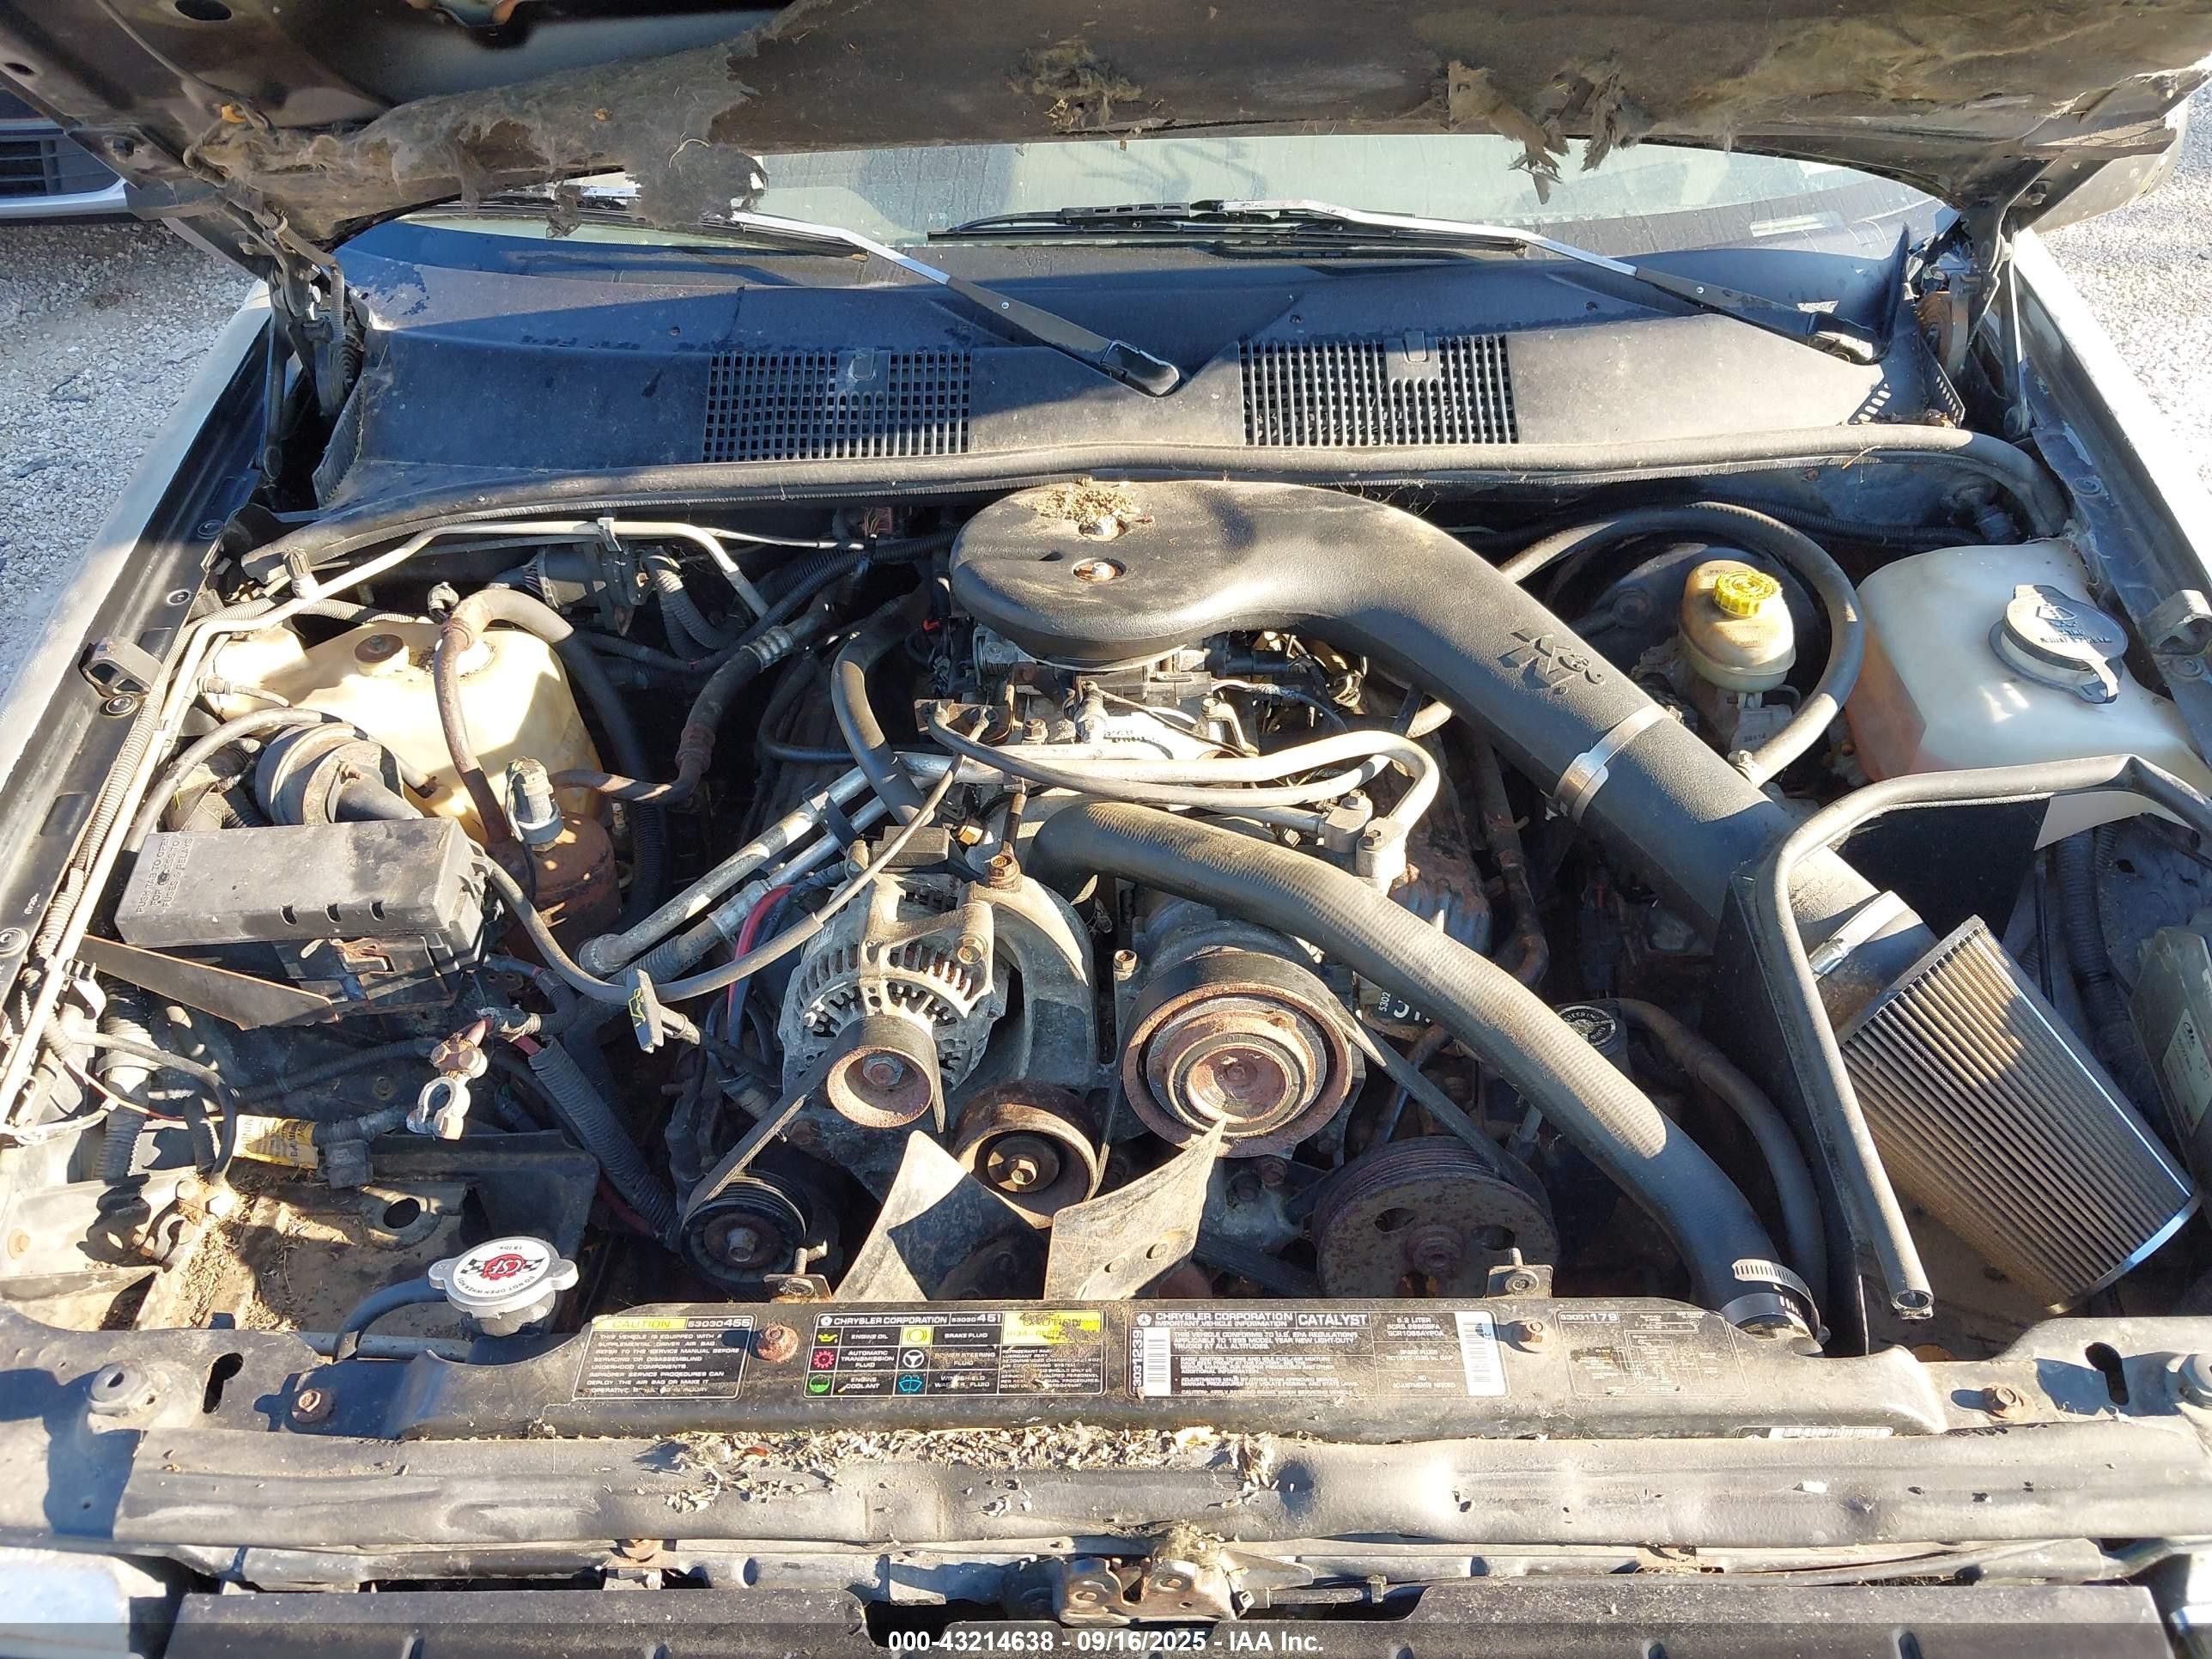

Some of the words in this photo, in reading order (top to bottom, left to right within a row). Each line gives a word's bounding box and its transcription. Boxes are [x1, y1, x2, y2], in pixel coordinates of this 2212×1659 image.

[171, 840, 179, 851] TO
[162, 881, 178, 908] FUSES
[176, 837, 193, 870] RELAYS
[137, 890, 149, 913] PUSH
[145, 872, 157, 887] TAB
[152, 860, 161, 871] TO
[492, 1259, 522, 1274] CSF
[507, 1282, 525, 1291] NOT
[688, 1318, 751, 1328] 53030455
[833, 1316, 882, 1326] CHRYSLER
[884, 1316, 947, 1325] CORPORATION
[951, 1313, 1002, 1323] 53030451
[1297, 1314, 1368, 1326] CATALYST
[612, 1320, 672, 1328] CAUTION
[1132, 1329, 1144, 1393] 3031239
